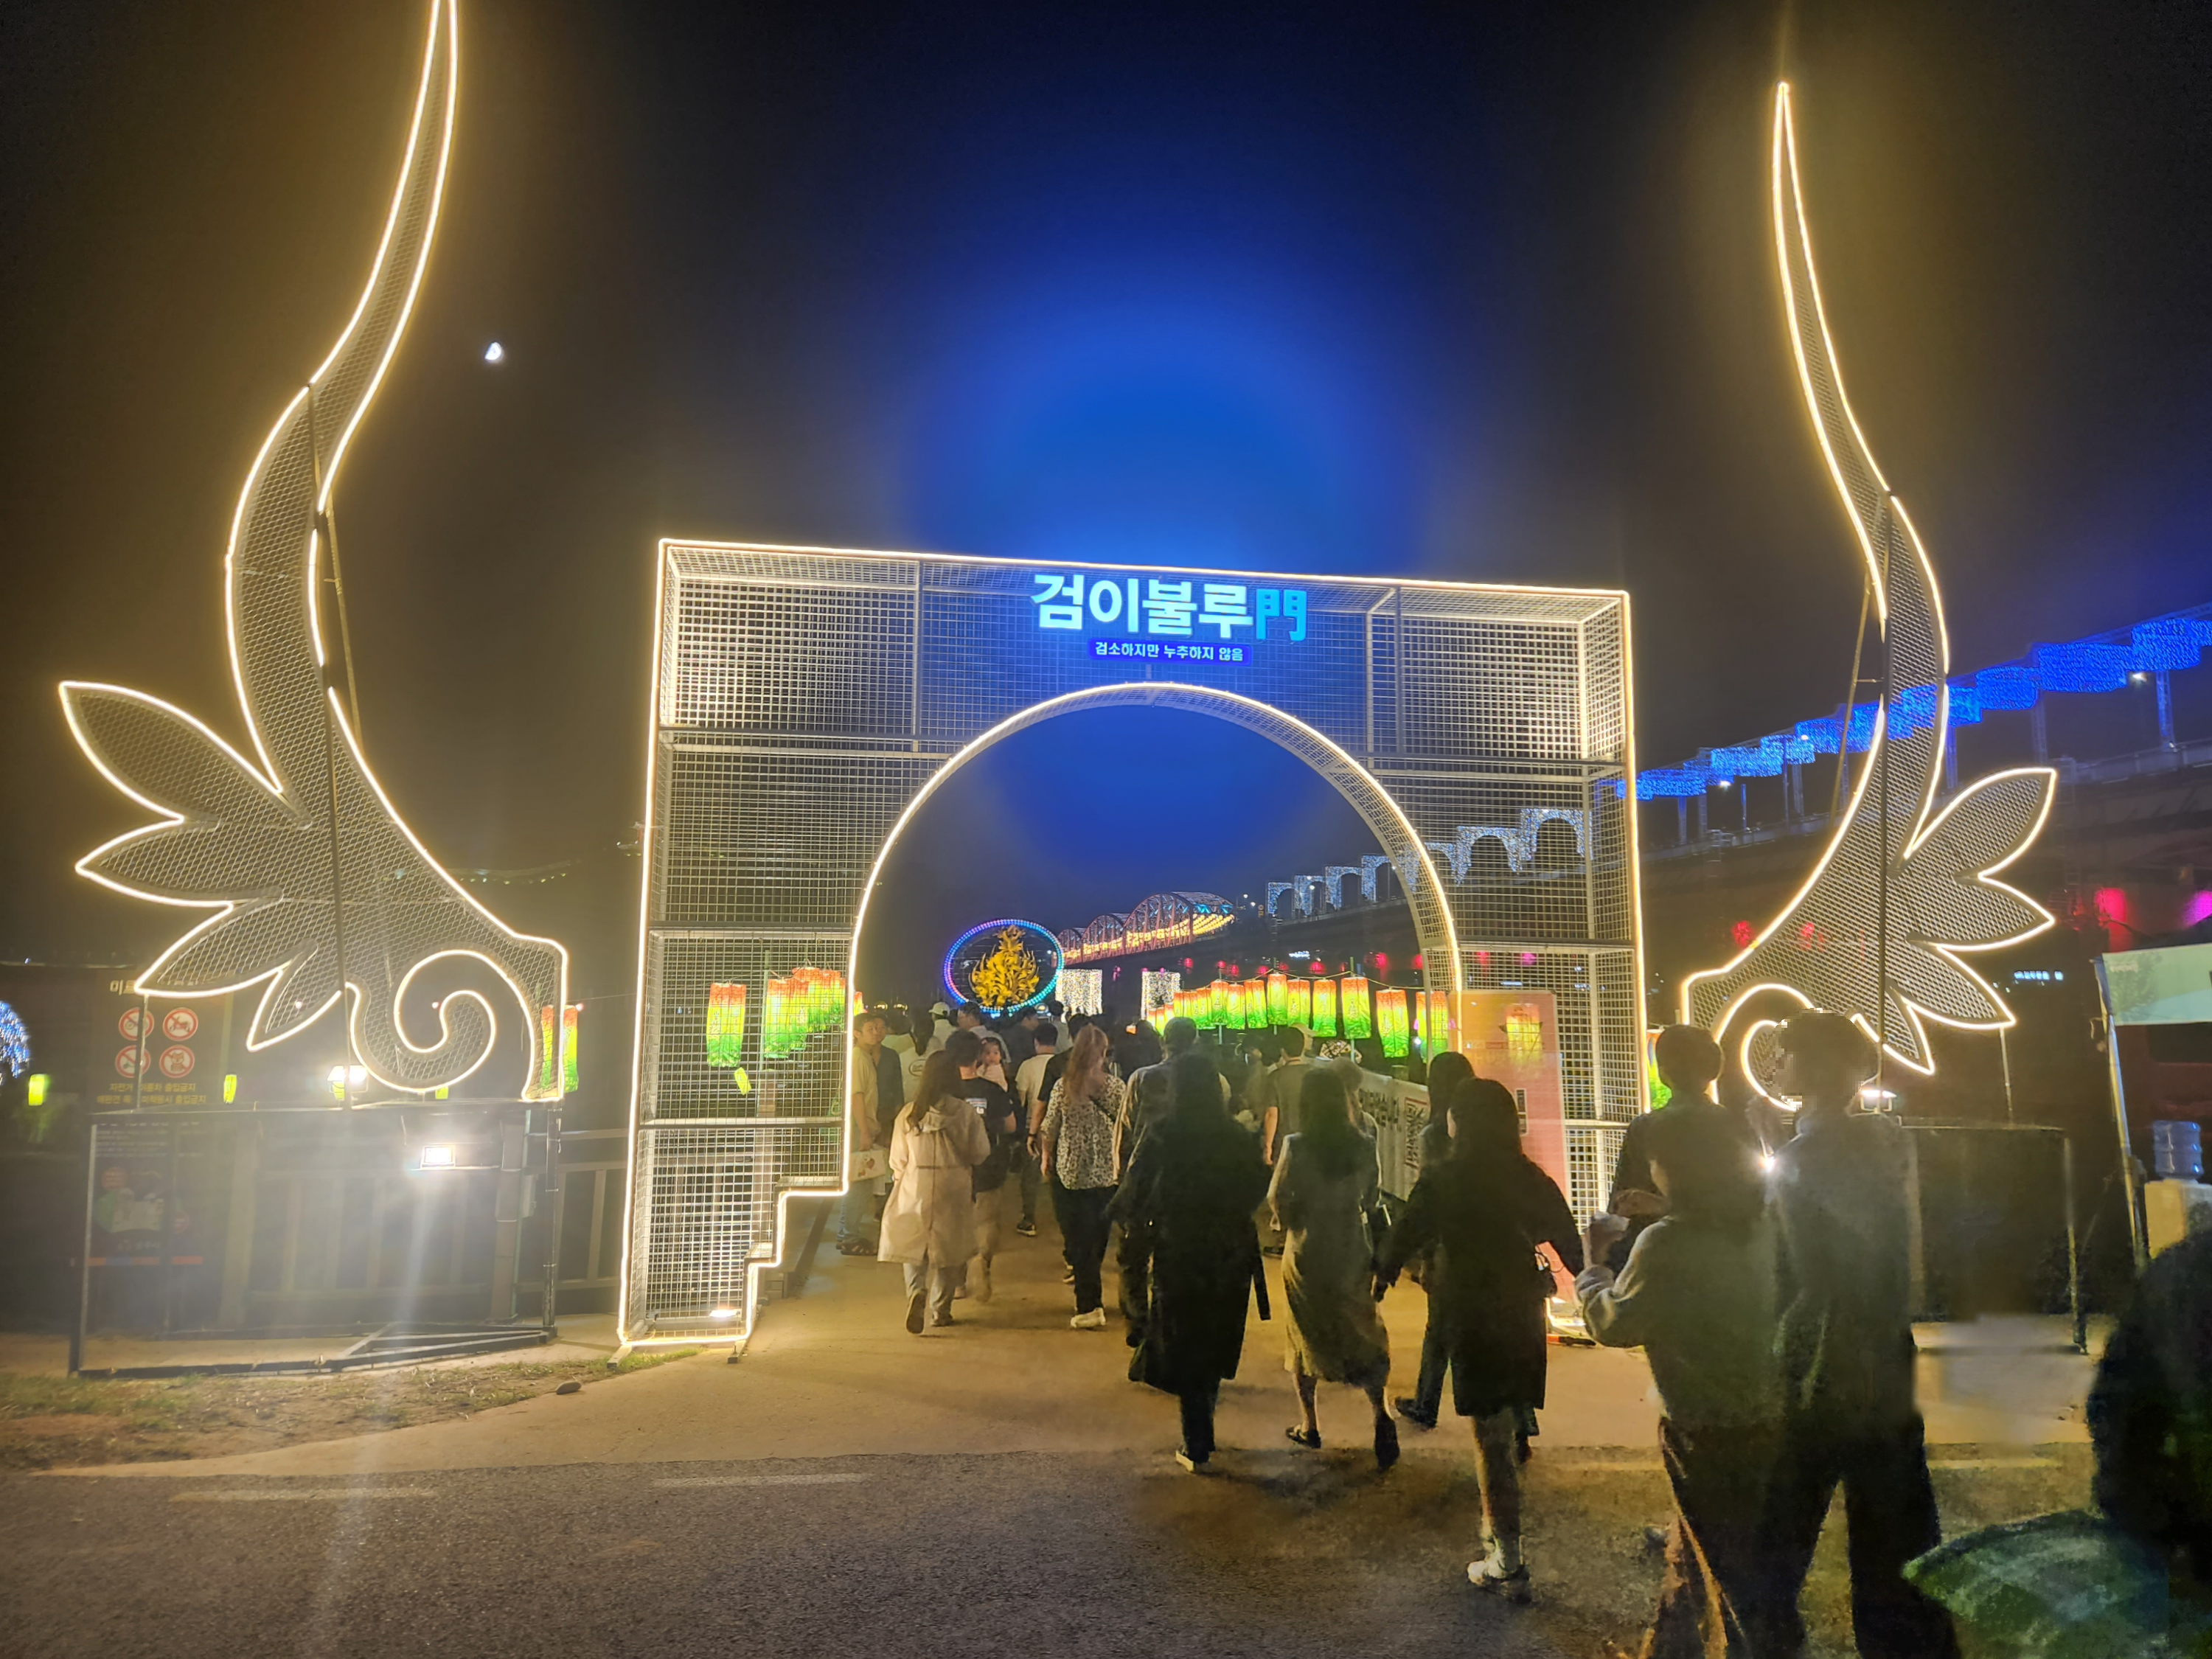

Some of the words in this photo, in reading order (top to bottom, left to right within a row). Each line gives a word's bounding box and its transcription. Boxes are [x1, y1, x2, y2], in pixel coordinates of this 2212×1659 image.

[1031, 574, 1307, 641] 검이불루門
[1095, 641, 1160, 658] 검소하지만
[1164, 644, 1214, 660] 누추하지
[1218, 647, 1244, 662] 않음
[109, 1082, 133, 1093] 자전거
[164, 1082, 196, 1093] 출입금지
[175, 1094, 206, 1105] 출입금지
